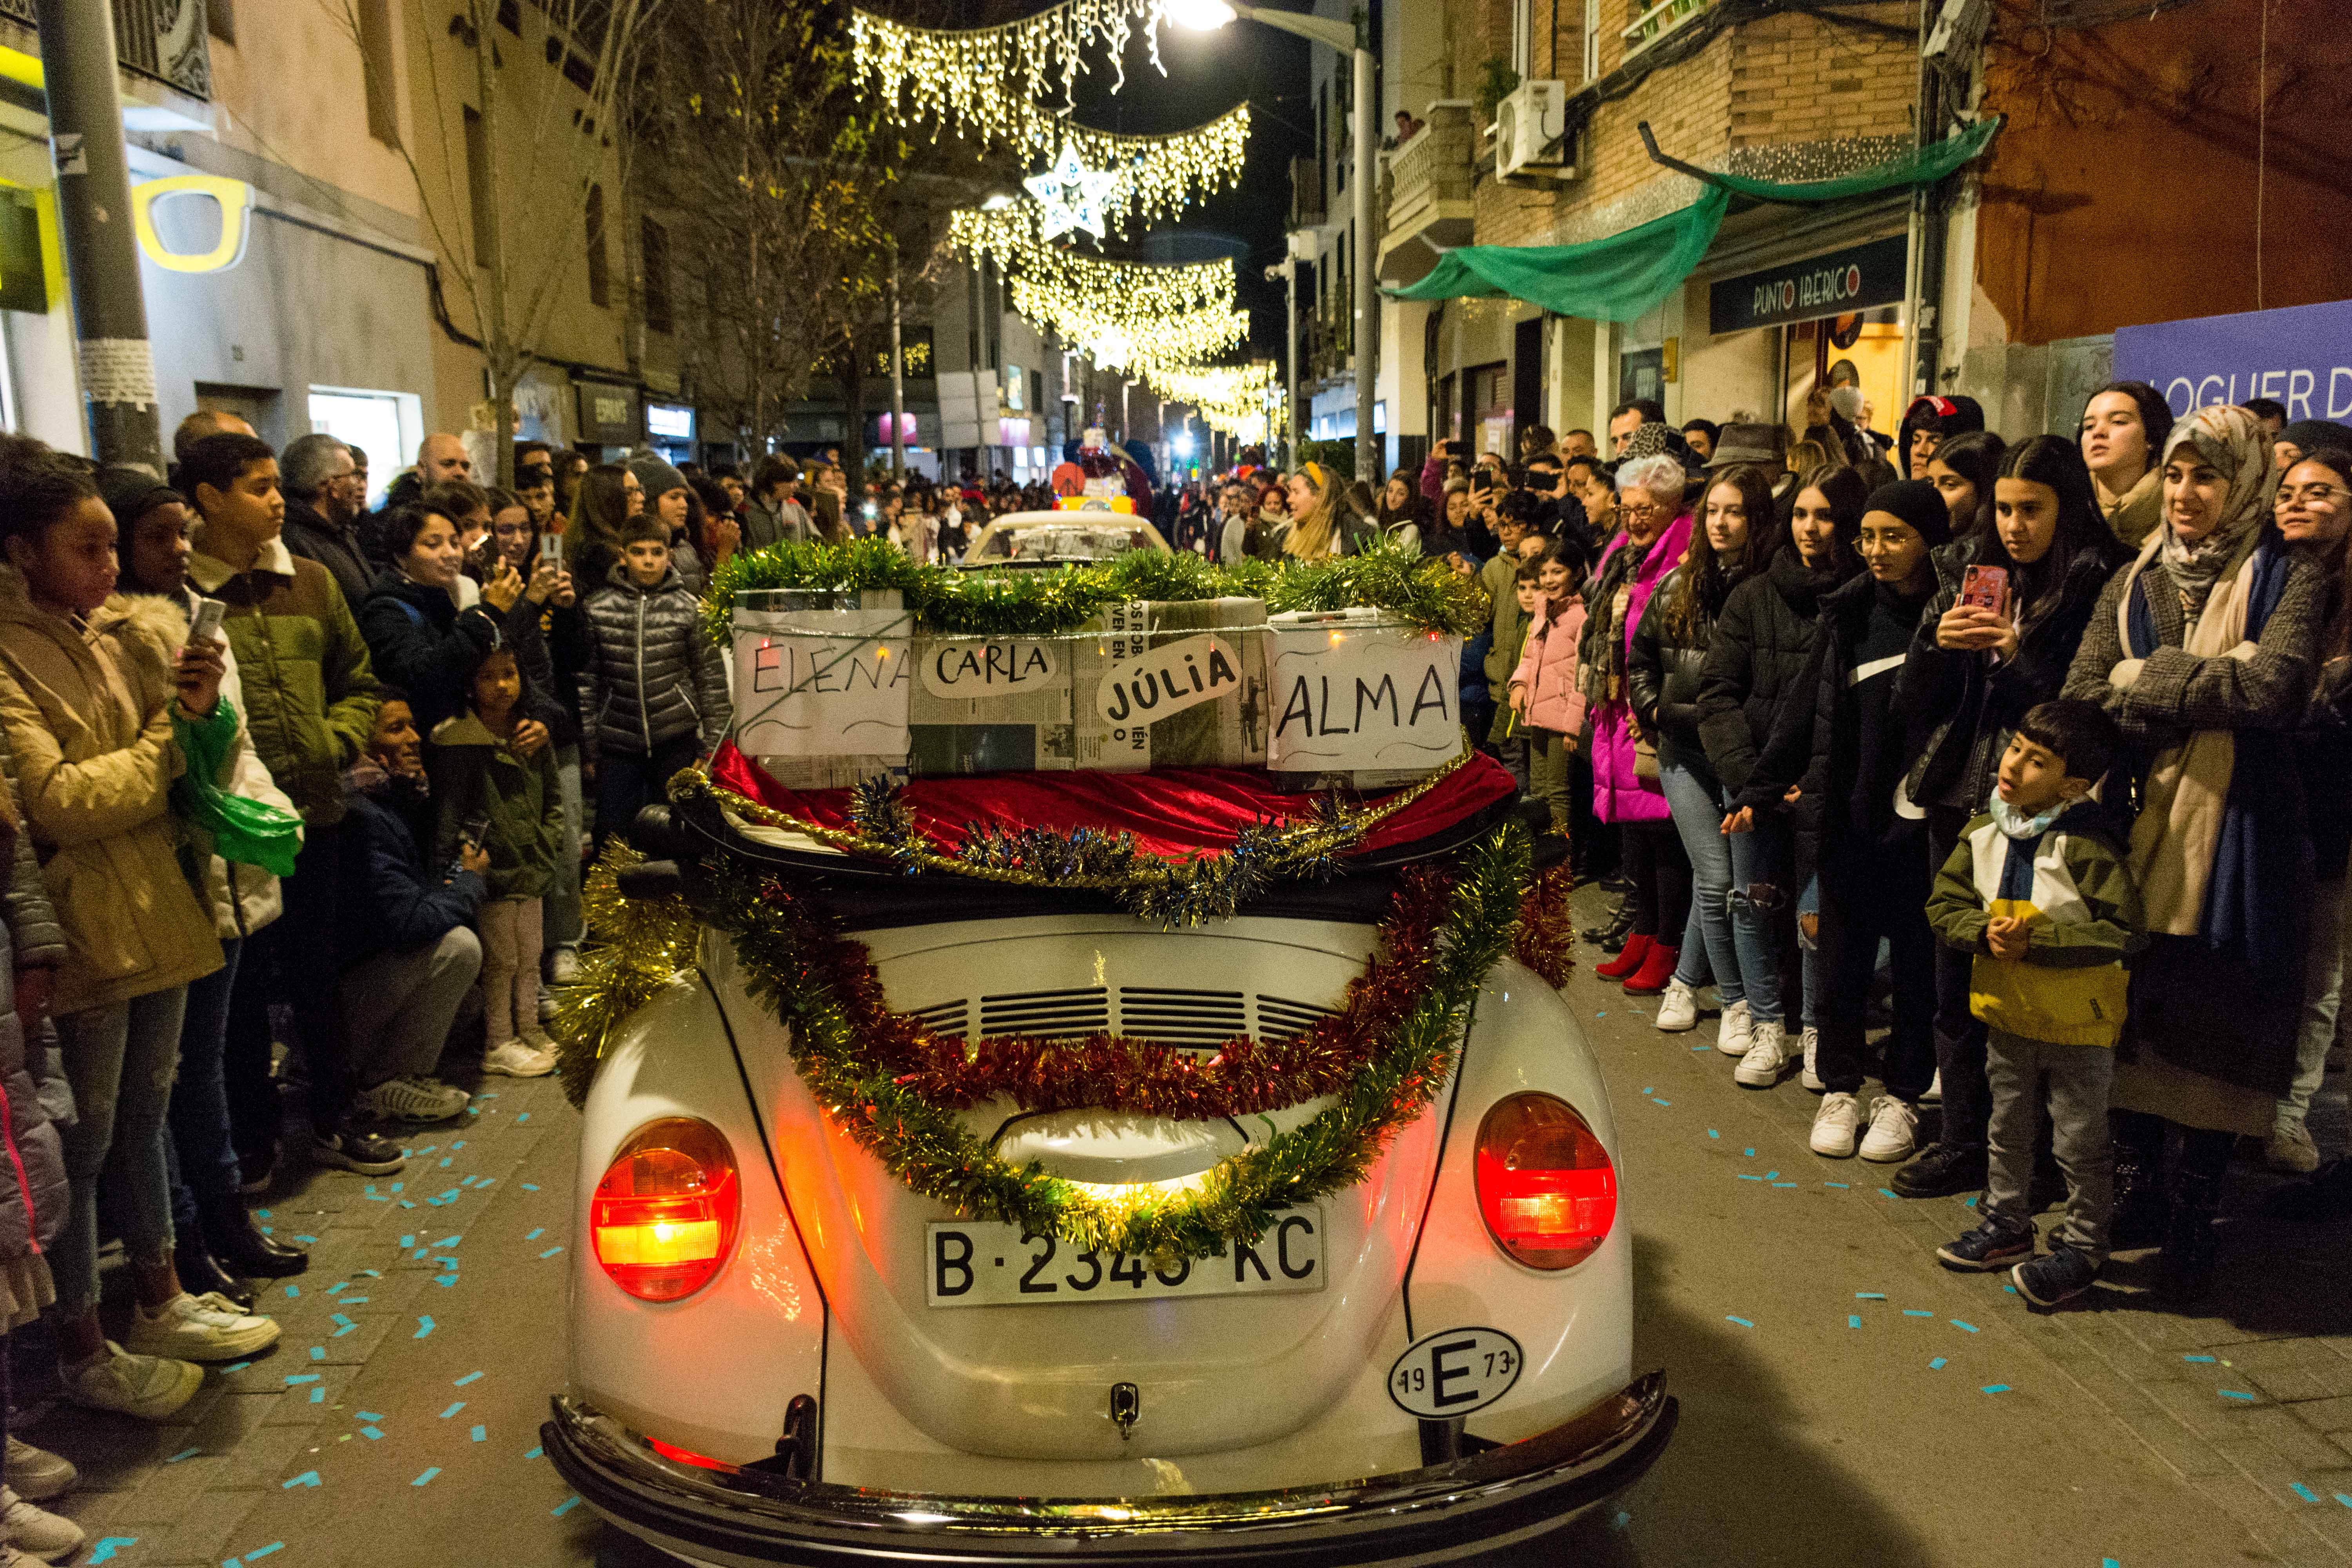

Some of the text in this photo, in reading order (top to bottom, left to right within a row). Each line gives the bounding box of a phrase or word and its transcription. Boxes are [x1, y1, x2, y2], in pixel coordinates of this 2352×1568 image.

[1754, 279, 1795, 315] PUNTO
[754, 644, 910, 693] ELENA
[936, 644, 1048, 684] CARLA
[1276, 664, 1448, 738] ALMA
[1400, 1339, 1511, 1408] 19 E 73
